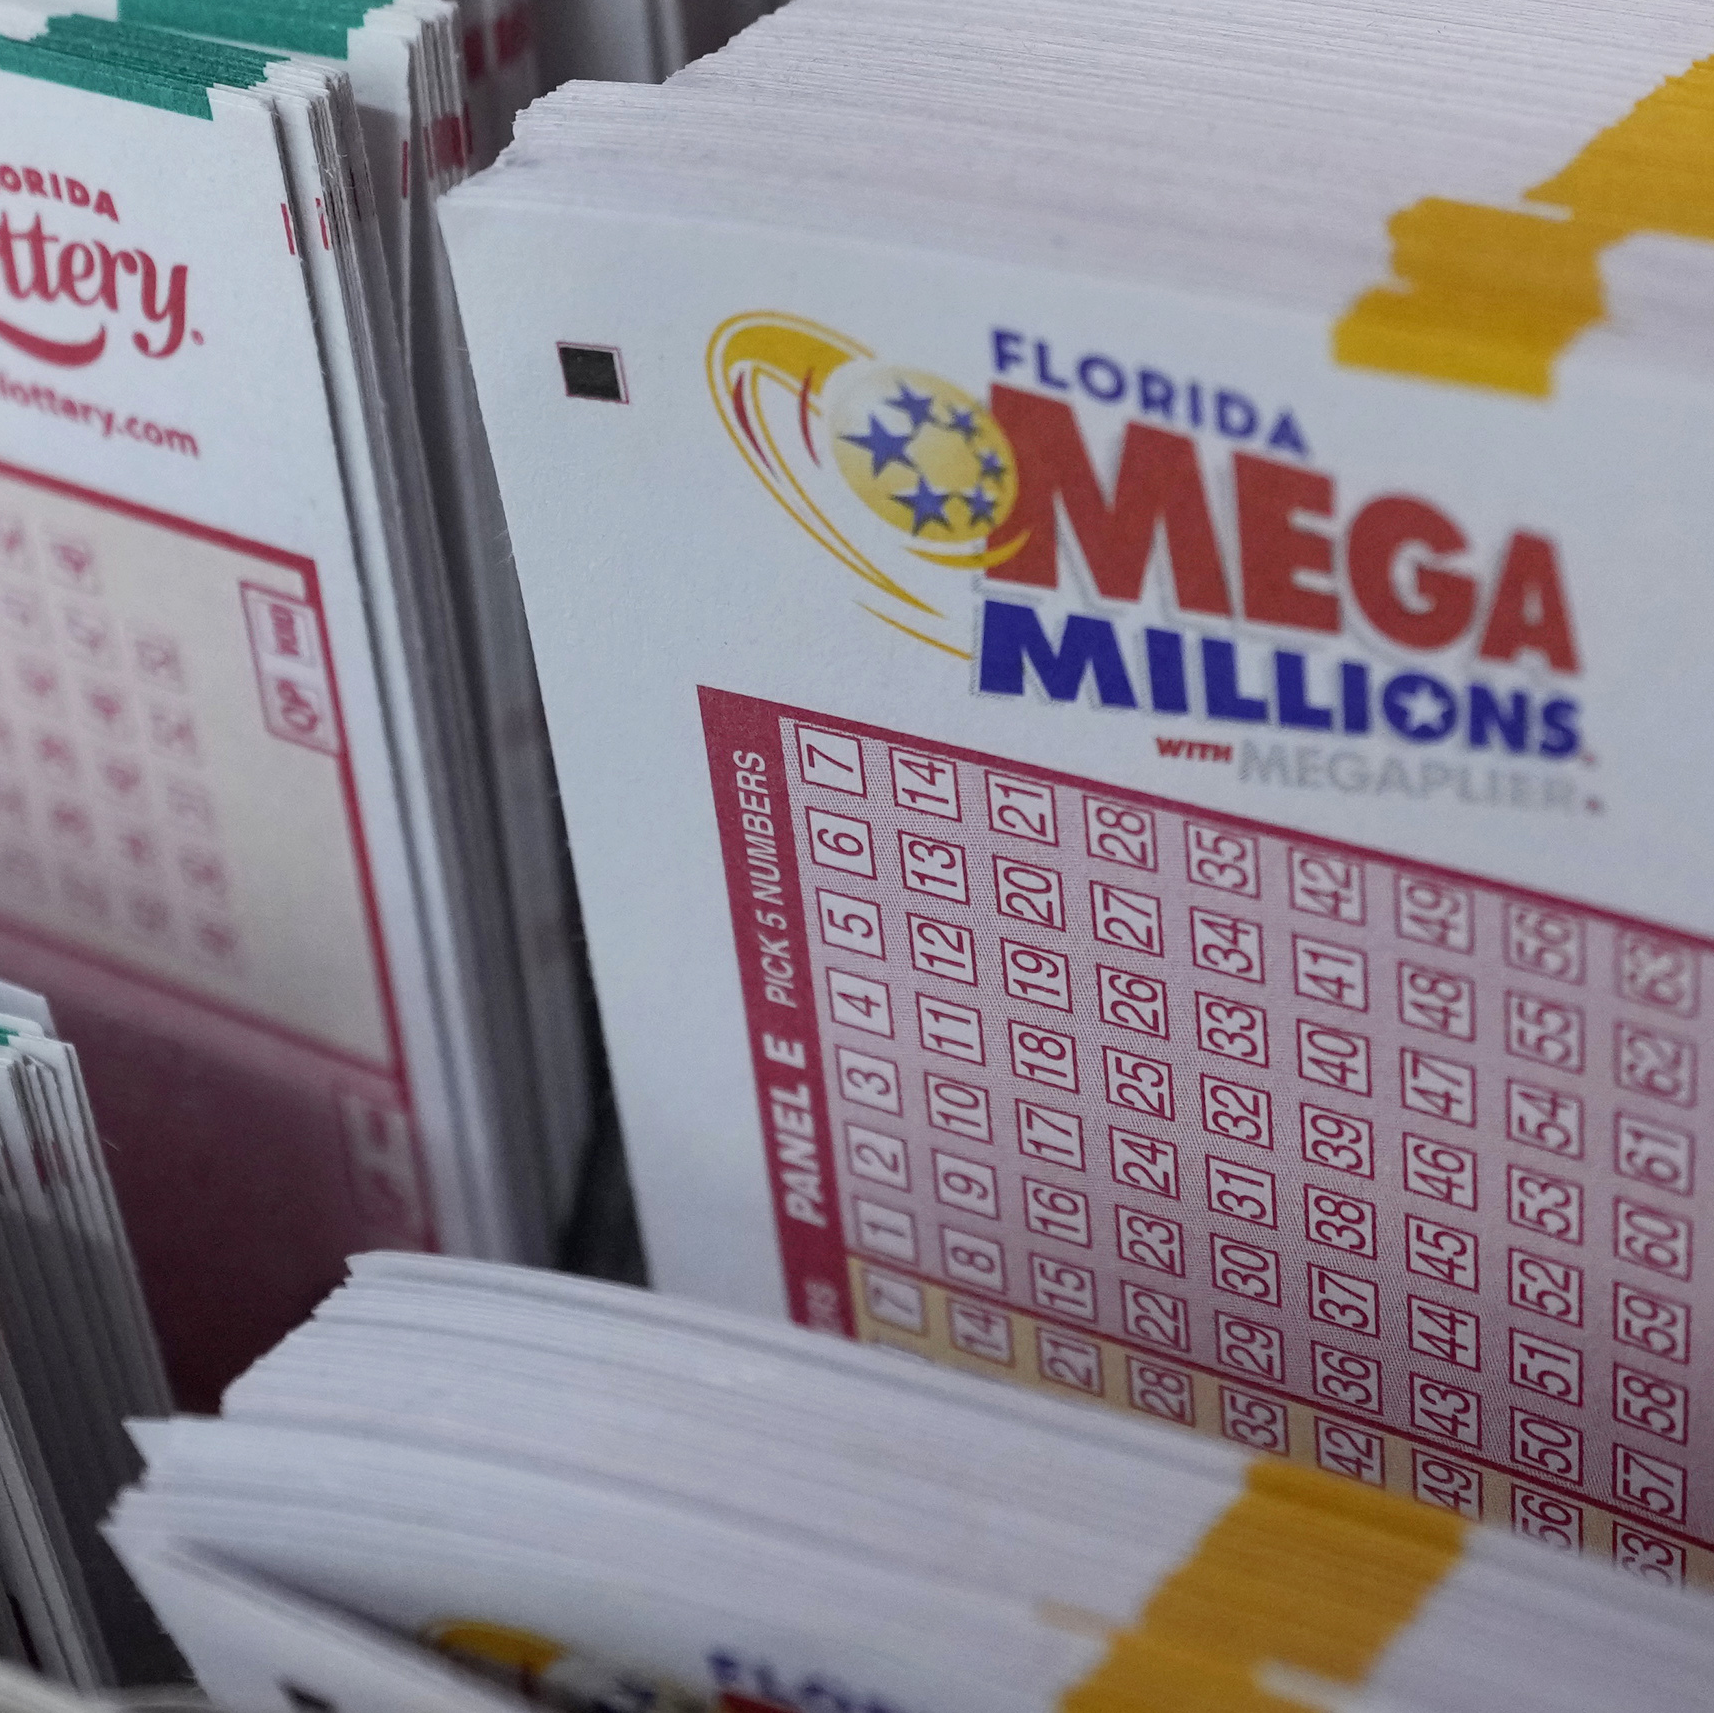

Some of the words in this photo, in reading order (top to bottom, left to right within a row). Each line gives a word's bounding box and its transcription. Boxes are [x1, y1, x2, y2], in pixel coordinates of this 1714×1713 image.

[990, 328, 1312, 457] FLORIDA
[982, 383, 1584, 675] MEGA
[979, 600, 1582, 761] MILLIONS
[808, 743, 854, 773] 7
[899, 758, 949, 805] 14
[1155, 736, 1232, 766] WITH
[1239, 740, 1577, 809] MEGAPLIER
[733, 750, 784, 905] NUMBERS
[995, 782, 1047, 837] 21
[1095, 805, 1147, 863] 28
[817, 827, 864, 857] 6
[908, 839, 957, 887] 13
[1195, 830, 1249, 889] 35
[1003, 865, 1055, 921] 20
[1299, 857, 1352, 914] 42
[757, 907, 787, 932] 5
[827, 908, 874, 939] 5
[1101, 889, 1153, 948] 27
[1406, 884, 1461, 943] 49
[761, 933, 797, 1008] PICK
[917, 921, 965, 969] 12
[1011, 949, 1060, 996] 19
[1200, 918, 1253, 974] 34
[1304, 949, 1353, 999] 41
[1408, 971, 1462, 1029] 48
[837, 991, 880, 1018] 4
[926, 1007, 973, 1050] 11
[1108, 974, 1158, 1031] 26
[1205, 1001, 1258, 1058] 33
[763, 1033, 807, 1069] E
[1018, 1031, 1067, 1078] 18
[1307, 1029, 1359, 1084] 40
[1516, 1001, 1572, 1062] 55
[846, 1066, 892, 1096] 3
[934, 1082, 981, 1128] 10
[1114, 1056, 1164, 1112] 25
[1411, 1057, 1461, 1114] 47
[1024, 1107, 1073, 1156] 17
[1210, 1084, 1262, 1140] 32
[1517, 1090, 1572, 1149] 54
[770, 1083, 828, 1229] PANEL
[854, 1142, 900, 1174] 2
[1121, 1138, 1170, 1191] 24
[1311, 1113, 1363, 1170] 39
[1625, 1127, 1681, 1183] 61
[943, 1170, 989, 1200] 9
[1216, 1169, 1266, 1220] 31
[1412, 1143, 1465, 1198] 46
[863, 1219, 907, 1239] 1
[1032, 1187, 1080, 1233] 16
[1314, 1194, 1366, 1251] 38
[1518, 1175, 1572, 1234] 53
[949, 1244, 996, 1274] 8
[1126, 1215, 1175, 1269] 23
[1416, 1225, 1467, 1279] 45
[1624, 1210, 1679, 1268] 60
[1038, 1262, 1086, 1307] 15
[1220, 1243, 1271, 1298] 30
[1518, 1258, 1572, 1316] 52
[1132, 1291, 1180, 1346] 22
[1317, 1272, 1369, 1329] 37
[1624, 1294, 1678, 1352] 59
[1224, 1323, 1277, 1380] 29
[1418, 1306, 1467, 1359] 44
[1049, 1338, 1092, 1388] 21
[1321, 1355, 1373, 1413] 36
[1520, 1343, 1571, 1396] 51
[1140, 1366, 1187, 1421] 28
[1232, 1393, 1279, 1448] 35
[1420, 1389, 1472, 1439] 43
[1623, 1375, 1677, 1432] 58
[1520, 1419, 1572, 1475] 50
[1623, 1454, 1675, 1512] 57
